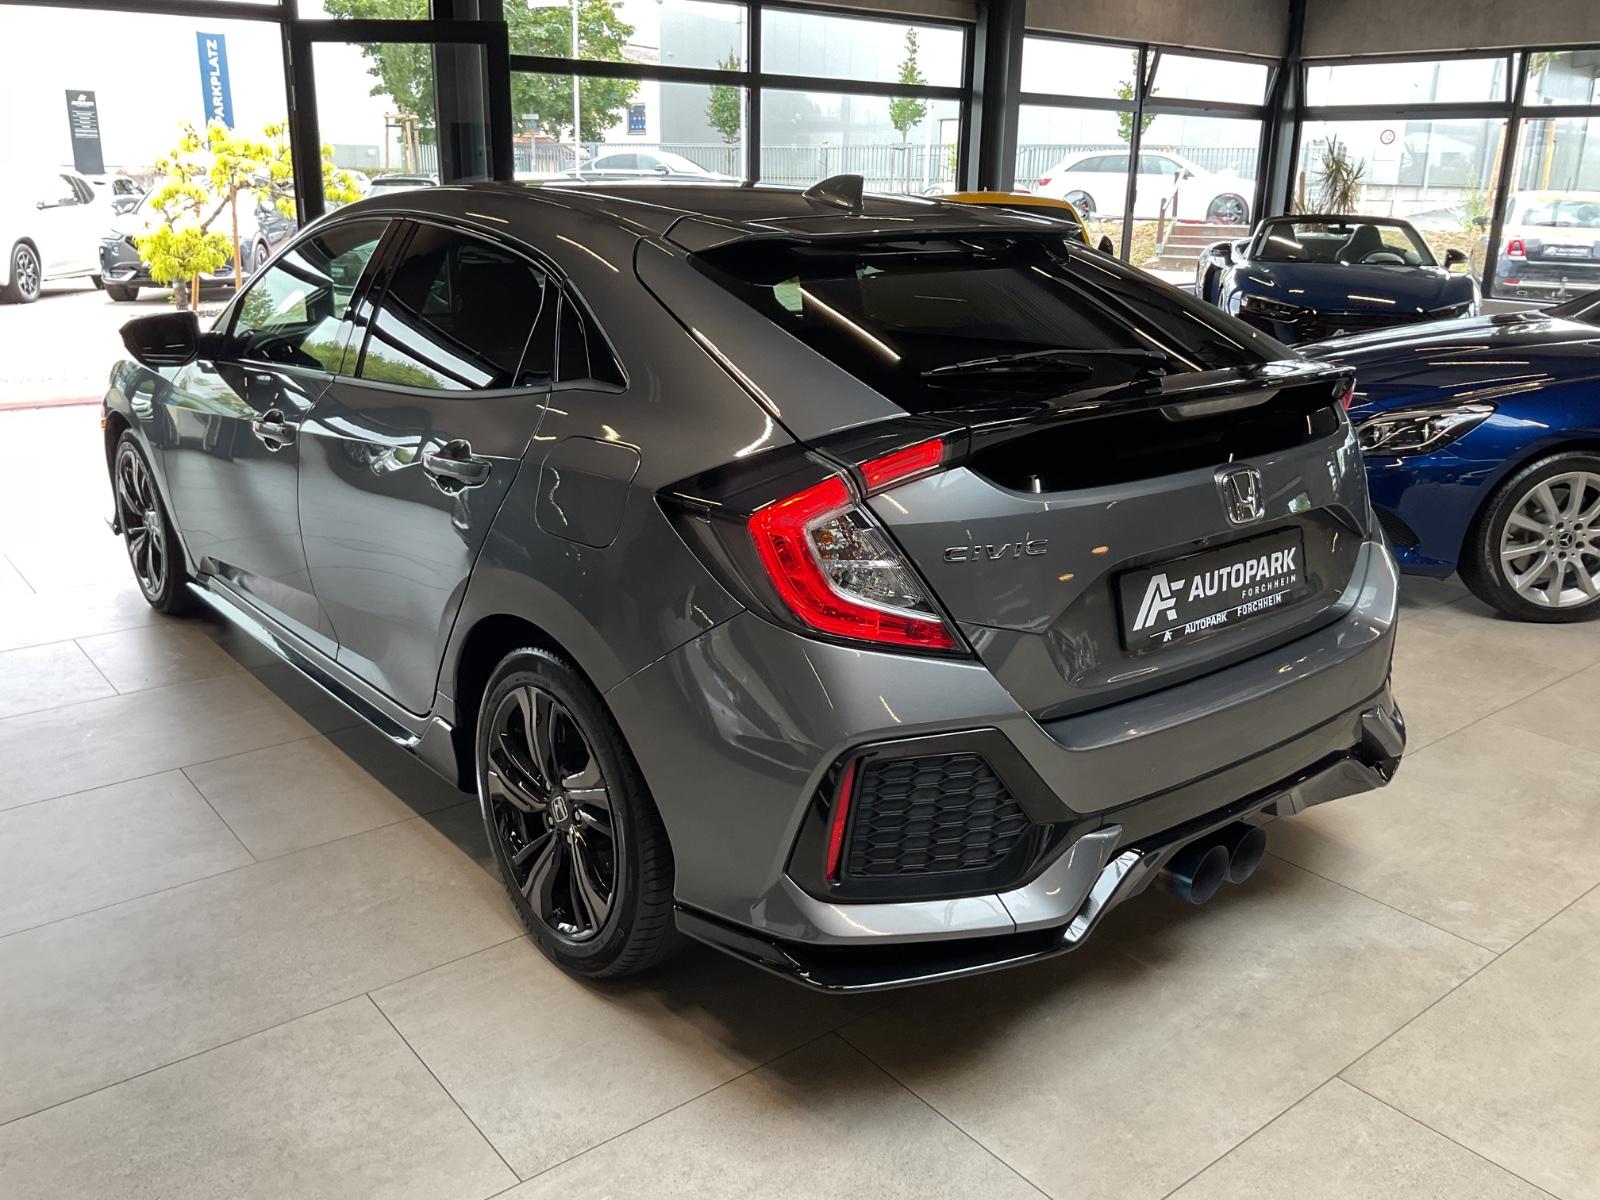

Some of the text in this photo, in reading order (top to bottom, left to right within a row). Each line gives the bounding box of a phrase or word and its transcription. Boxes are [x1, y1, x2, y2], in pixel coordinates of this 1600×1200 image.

[943, 539, 1048, 562] CIVIC
[1188, 547, 1296, 602] AUTOPARK
[1241, 574, 1297, 599] FORCHHEIM
[1184, 611, 1228, 635] AUTOPARK
[1237, 593, 1282, 617] FORCHHEIM
